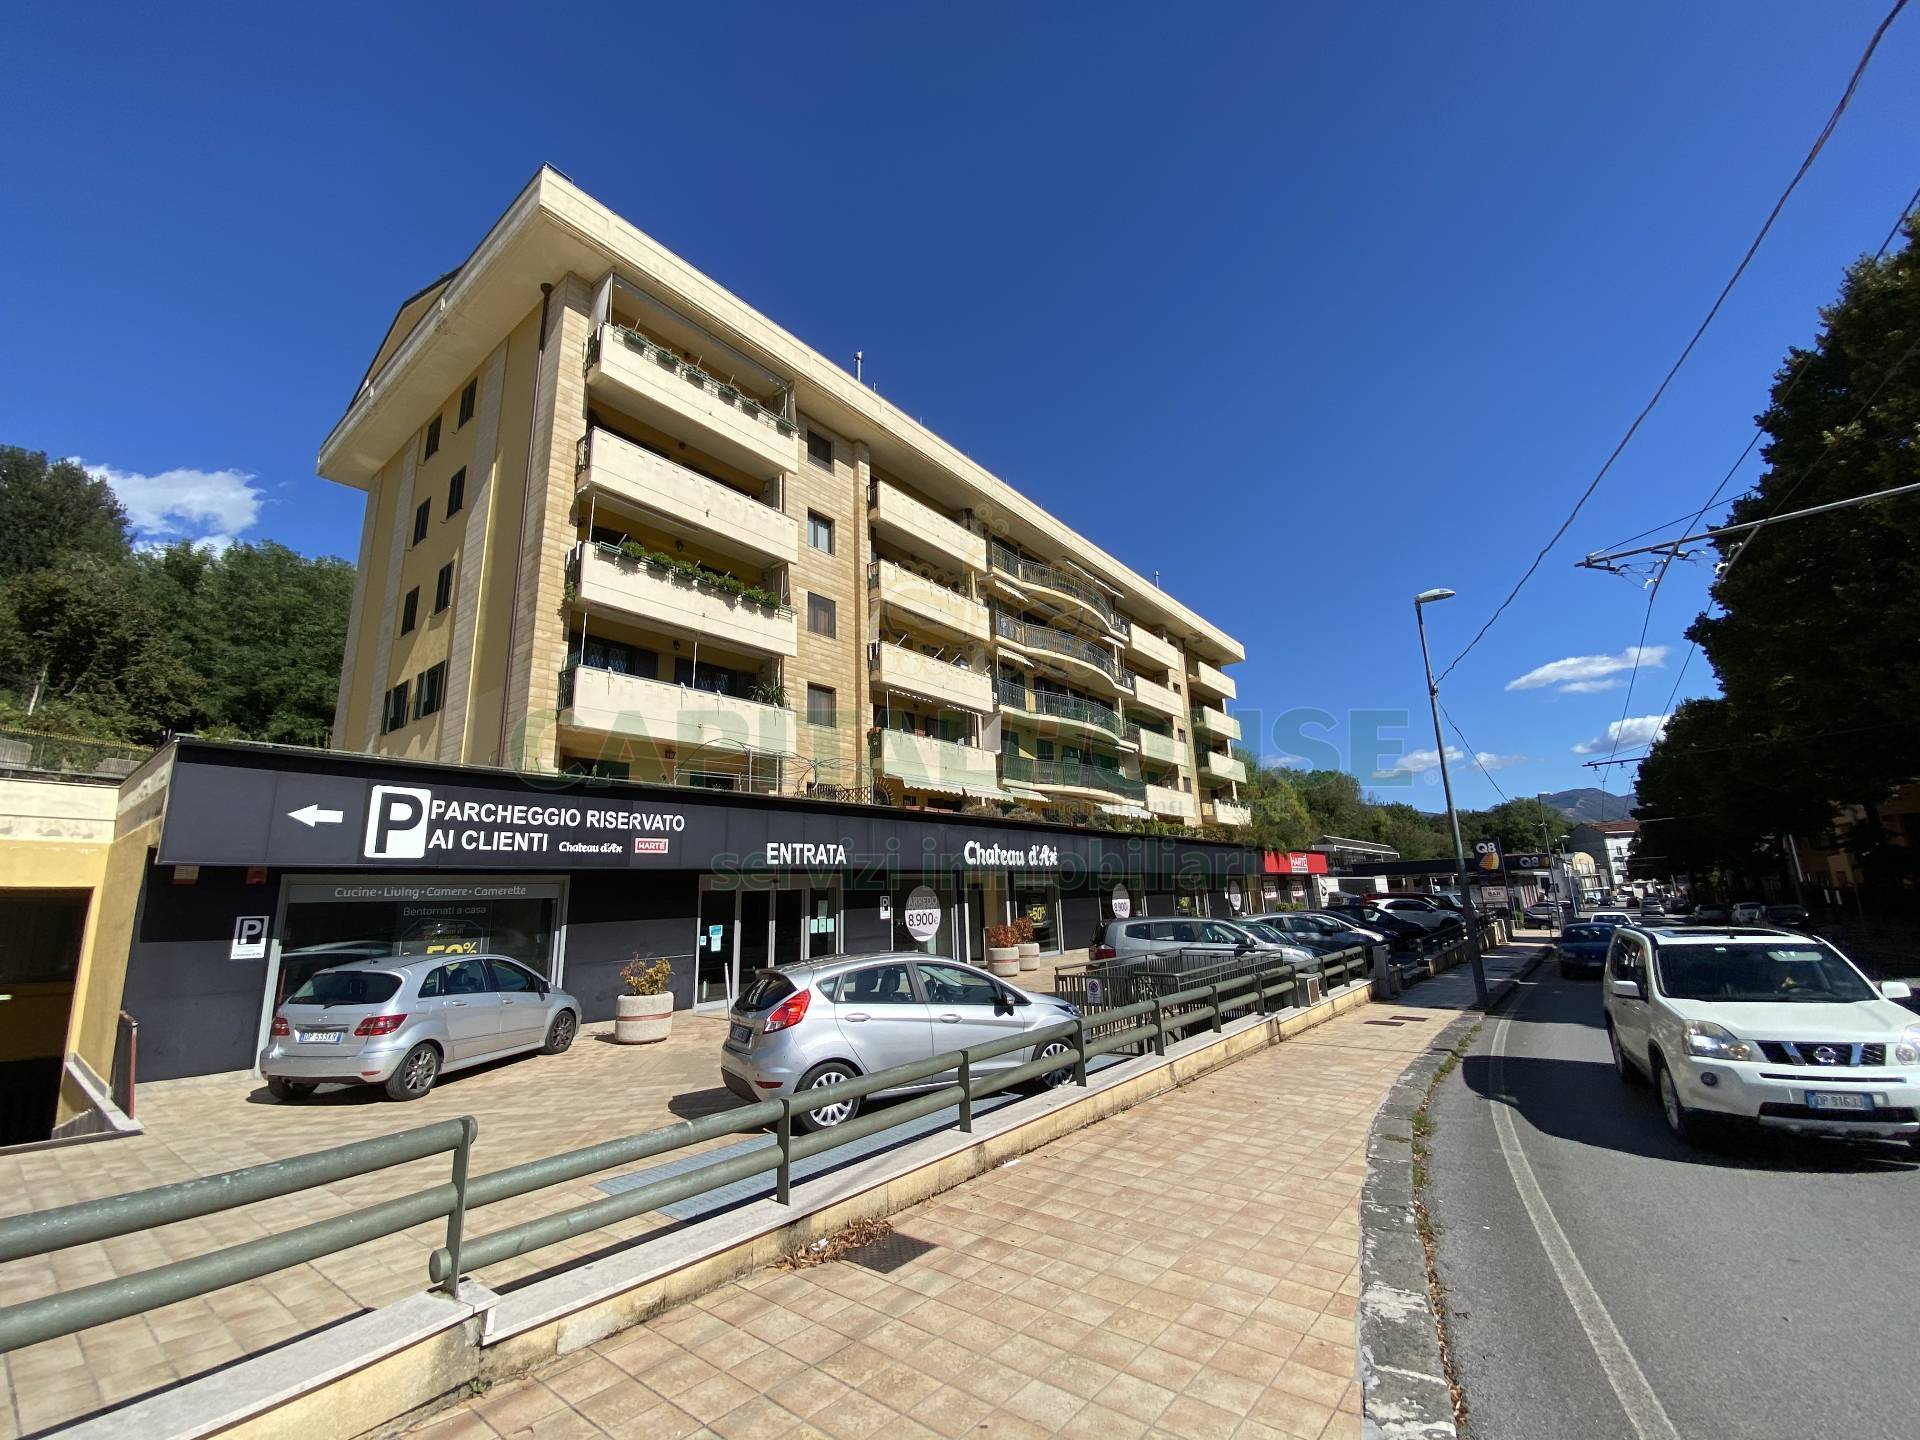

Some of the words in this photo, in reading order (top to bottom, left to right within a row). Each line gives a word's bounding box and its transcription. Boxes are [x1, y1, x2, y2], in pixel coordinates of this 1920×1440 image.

[374, 792, 423, 854] P
[430, 799, 580, 827] PARCHEGGIO
[586, 810, 685, 832] RISERVATO
[428, 830, 455, 850] AI
[461, 830, 548, 852] CLIENTI
[558, 841, 599, 853] Chateau
[1476, 842, 1496, 853] Q8
[766, 842, 847, 866] ENTRATA
[963, 840, 1026, 867] Chateau
[1520, 856, 1540, 868] Q8
[334, 886, 377, 898] Cucine
[383, 886, 420, 900] Living
[426, 887, 468, 897] Camere
[474, 886, 527, 897] Camerette
[908, 897, 938, 905] ARREDO
[465, 906, 487, 914] casa
[240, 919, 262, 945] P
